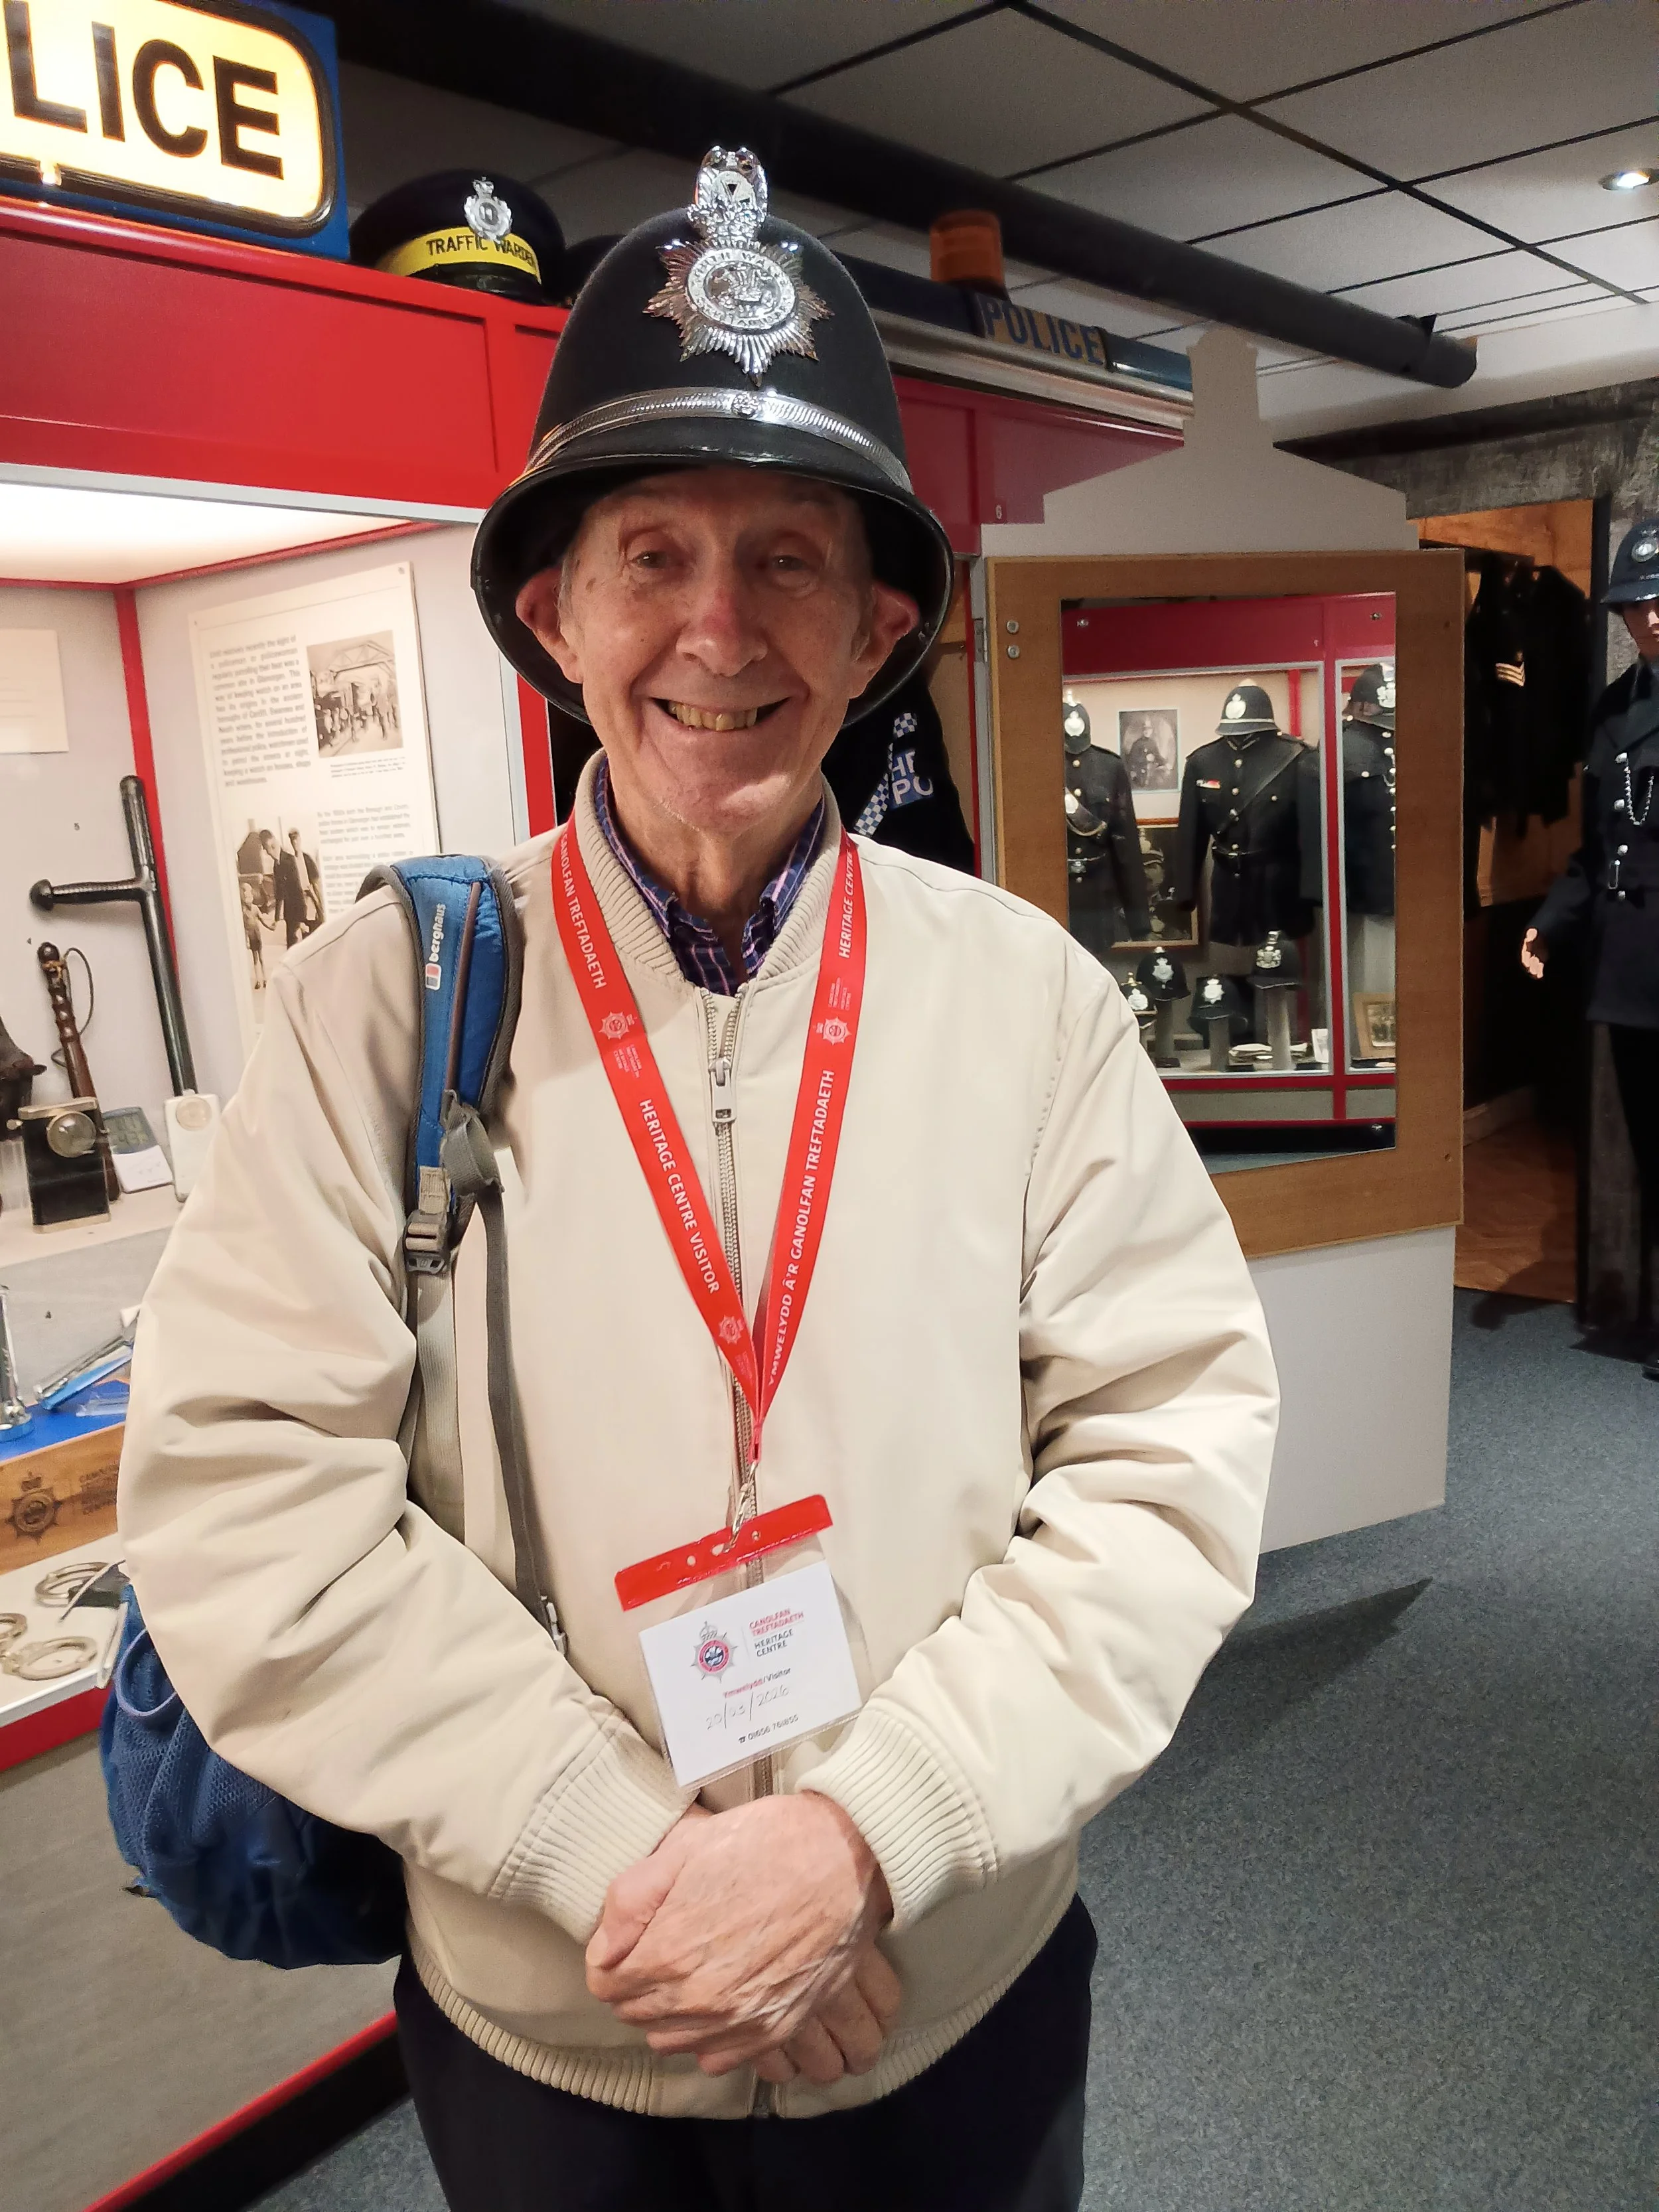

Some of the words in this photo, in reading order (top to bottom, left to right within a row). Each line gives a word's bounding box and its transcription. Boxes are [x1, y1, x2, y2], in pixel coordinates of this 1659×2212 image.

[426, 236, 488, 256] TRAFFIC
[985, 301, 1104, 365] POLICE
[843, 849, 854, 896] CENTRE
[429, 903, 446, 962] berghaus
[567, 897, 607, 990] TREFTADAETH
[838, 899, 853, 959] HERITAGE
[639, 1099, 676, 1171] HERITAGE
[668, 1173, 697, 1232] CENTRE
[689, 1231, 721, 1295] VISITOR
[768, 1293, 792, 1386] YMWELYDD
[790, 1175, 815, 1260] GANOLFAN
[806, 1070, 835, 1171] TREFTADAETH
[749, 1608, 790, 1629] CANOLFAN
[755, 1629, 794, 1649] HERITAGE
[757, 1640, 787, 1657] CENTRE
